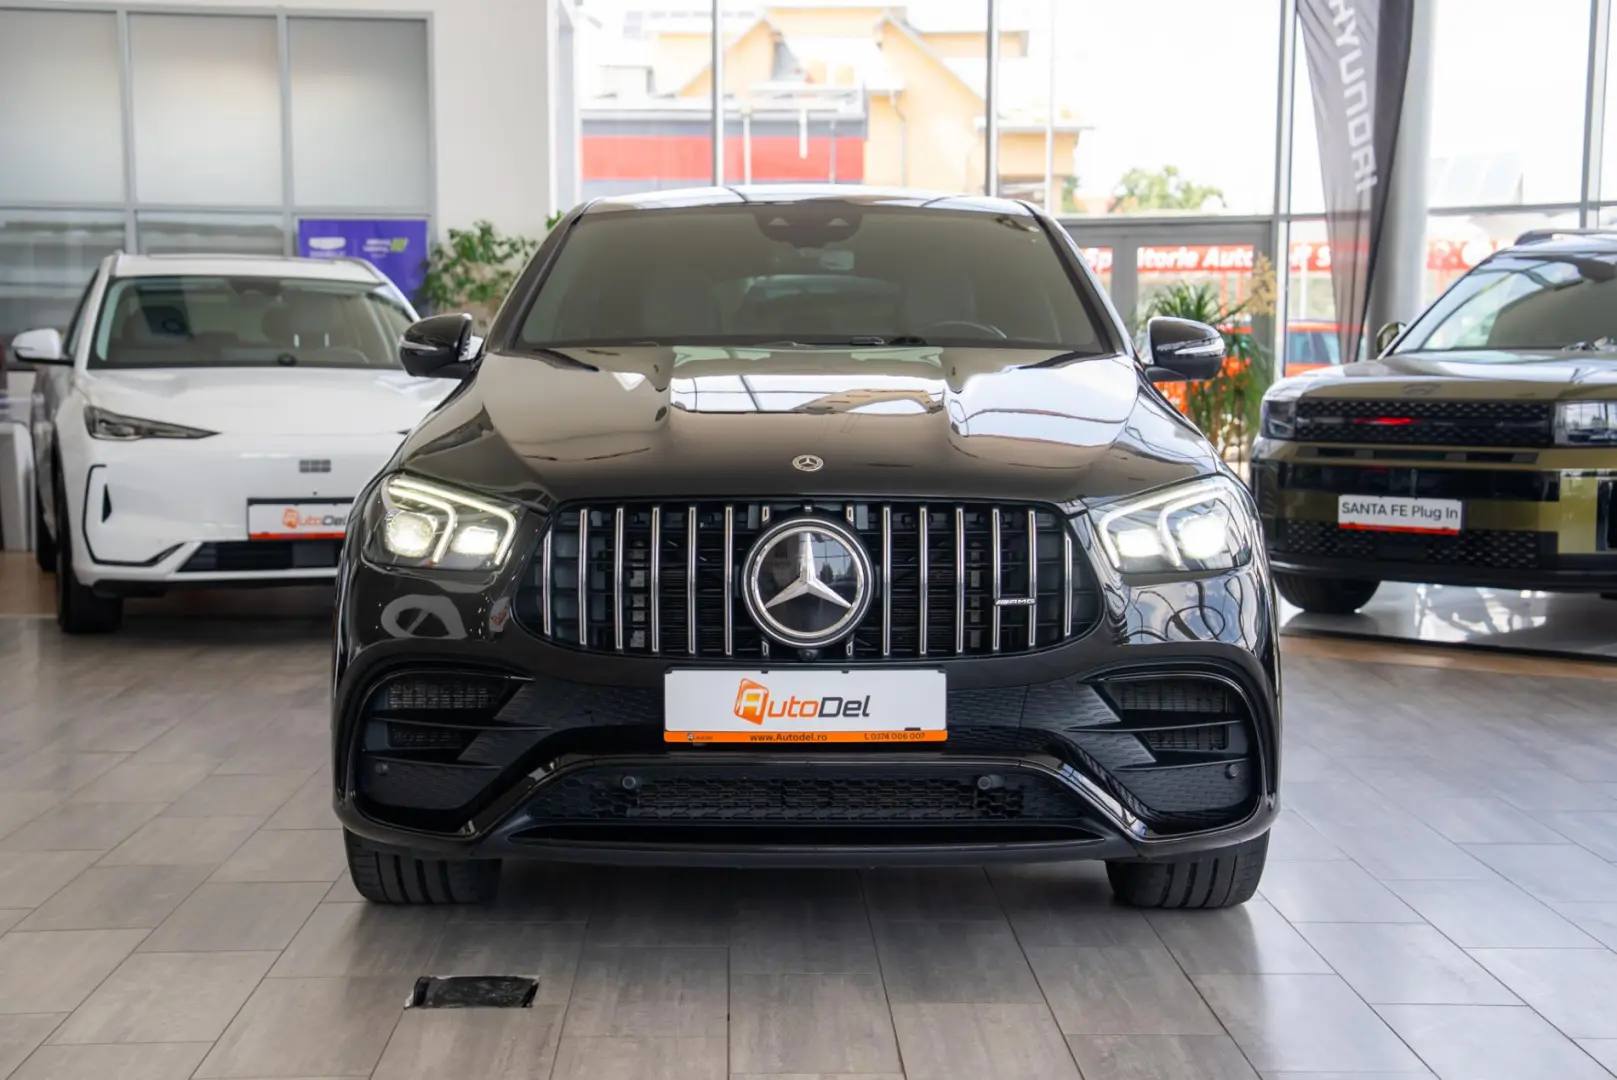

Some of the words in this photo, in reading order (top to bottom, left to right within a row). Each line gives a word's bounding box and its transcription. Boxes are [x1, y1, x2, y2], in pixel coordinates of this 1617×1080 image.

[1329, 0, 1378, 192] HYUNDAI
[1342, 502, 1387, 516] SANTA
[1391, 504, 1408, 517] FE
[1412, 505, 1442, 520] Plug
[1446, 507, 1458, 519] In
[737, 685, 871, 719] AutoDel
[750, 733, 828, 742] www.Autodel.ro
